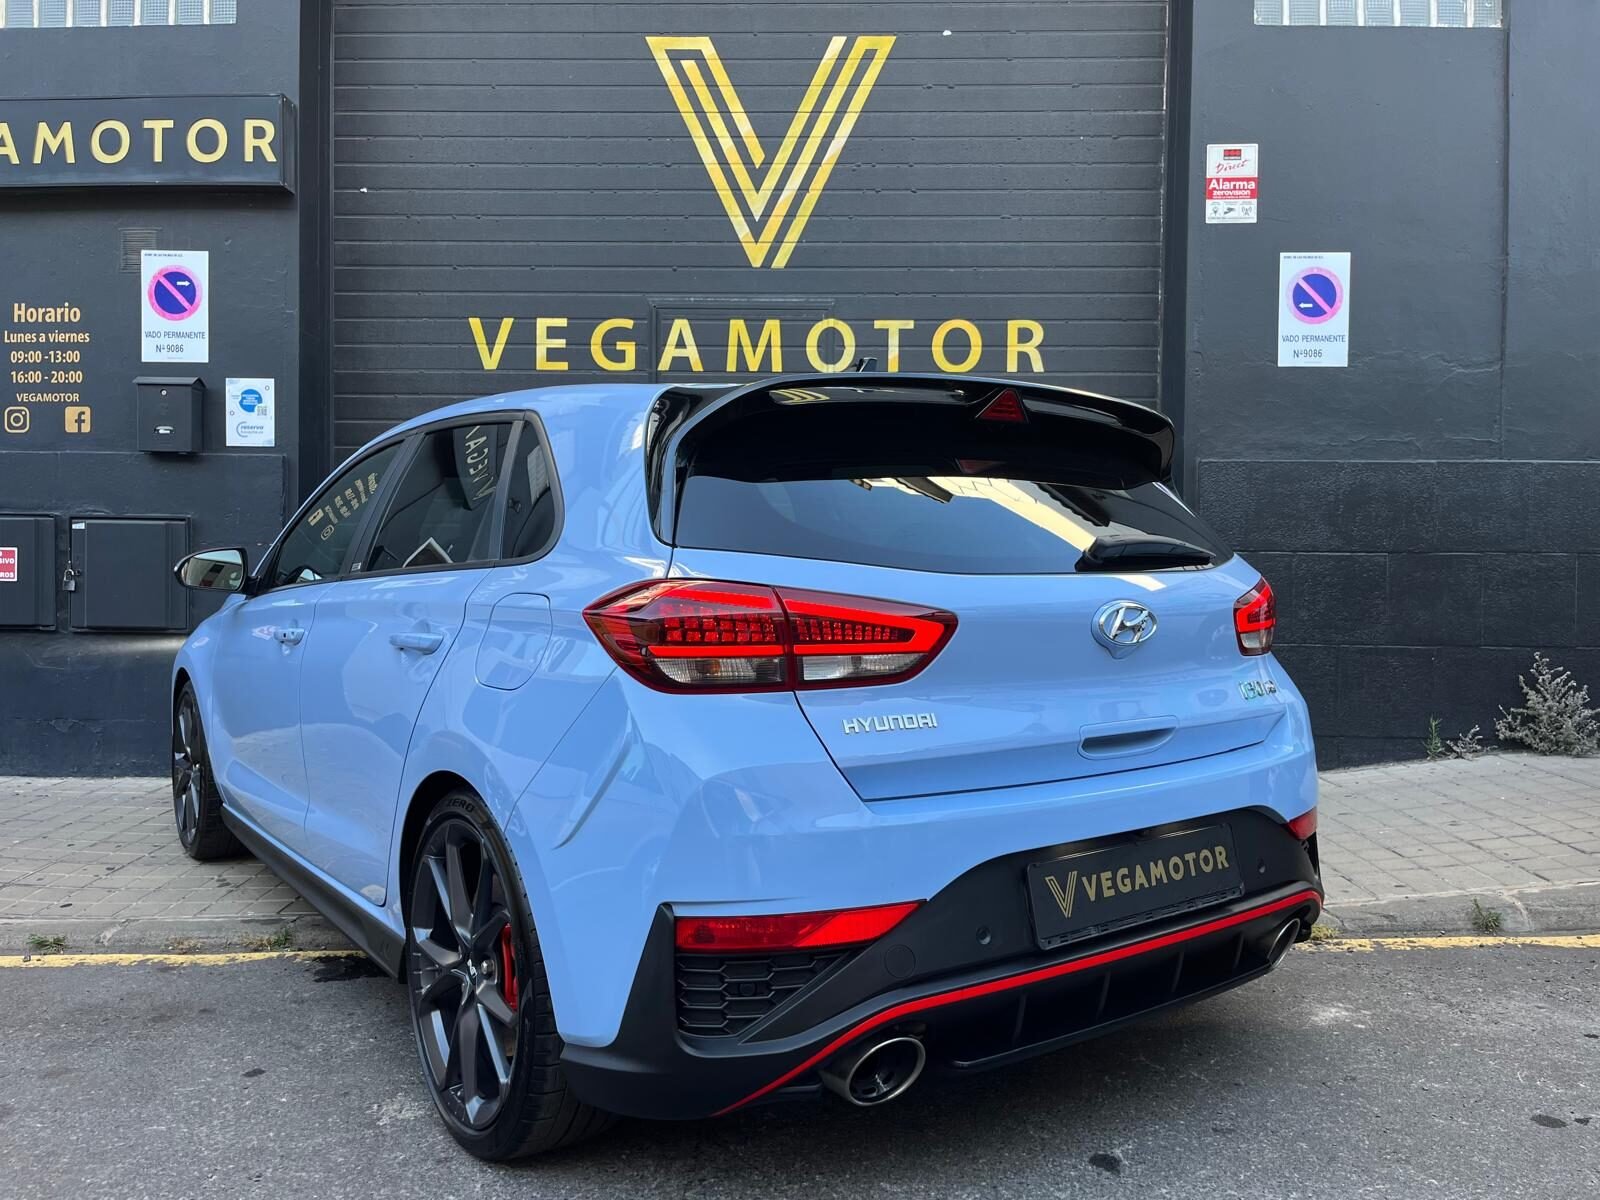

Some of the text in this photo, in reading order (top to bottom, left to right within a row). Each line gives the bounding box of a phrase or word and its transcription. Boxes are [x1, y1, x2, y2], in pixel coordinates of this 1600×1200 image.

[1209, 179, 1256, 190] Alarma
[13, 302, 81, 323] Horario
[4, 330, 90, 343] Lunes a viernes
[144, 331, 206, 339] VADO PERMANENTE
[1281, 335, 1346, 343] VADO PERMANENTE
[468, 317, 1046, 373] VEGAMOTOR
[10, 351, 42, 363] 09:00
[10, 371, 42, 383] 16:00
[51, 371, 83, 383] 20:00
[16, 393, 80, 402] VEGAMOTOR
[842, 712, 938, 735] HYUNDAI
[1082, 845, 1230, 902] VEGAMOTOR
